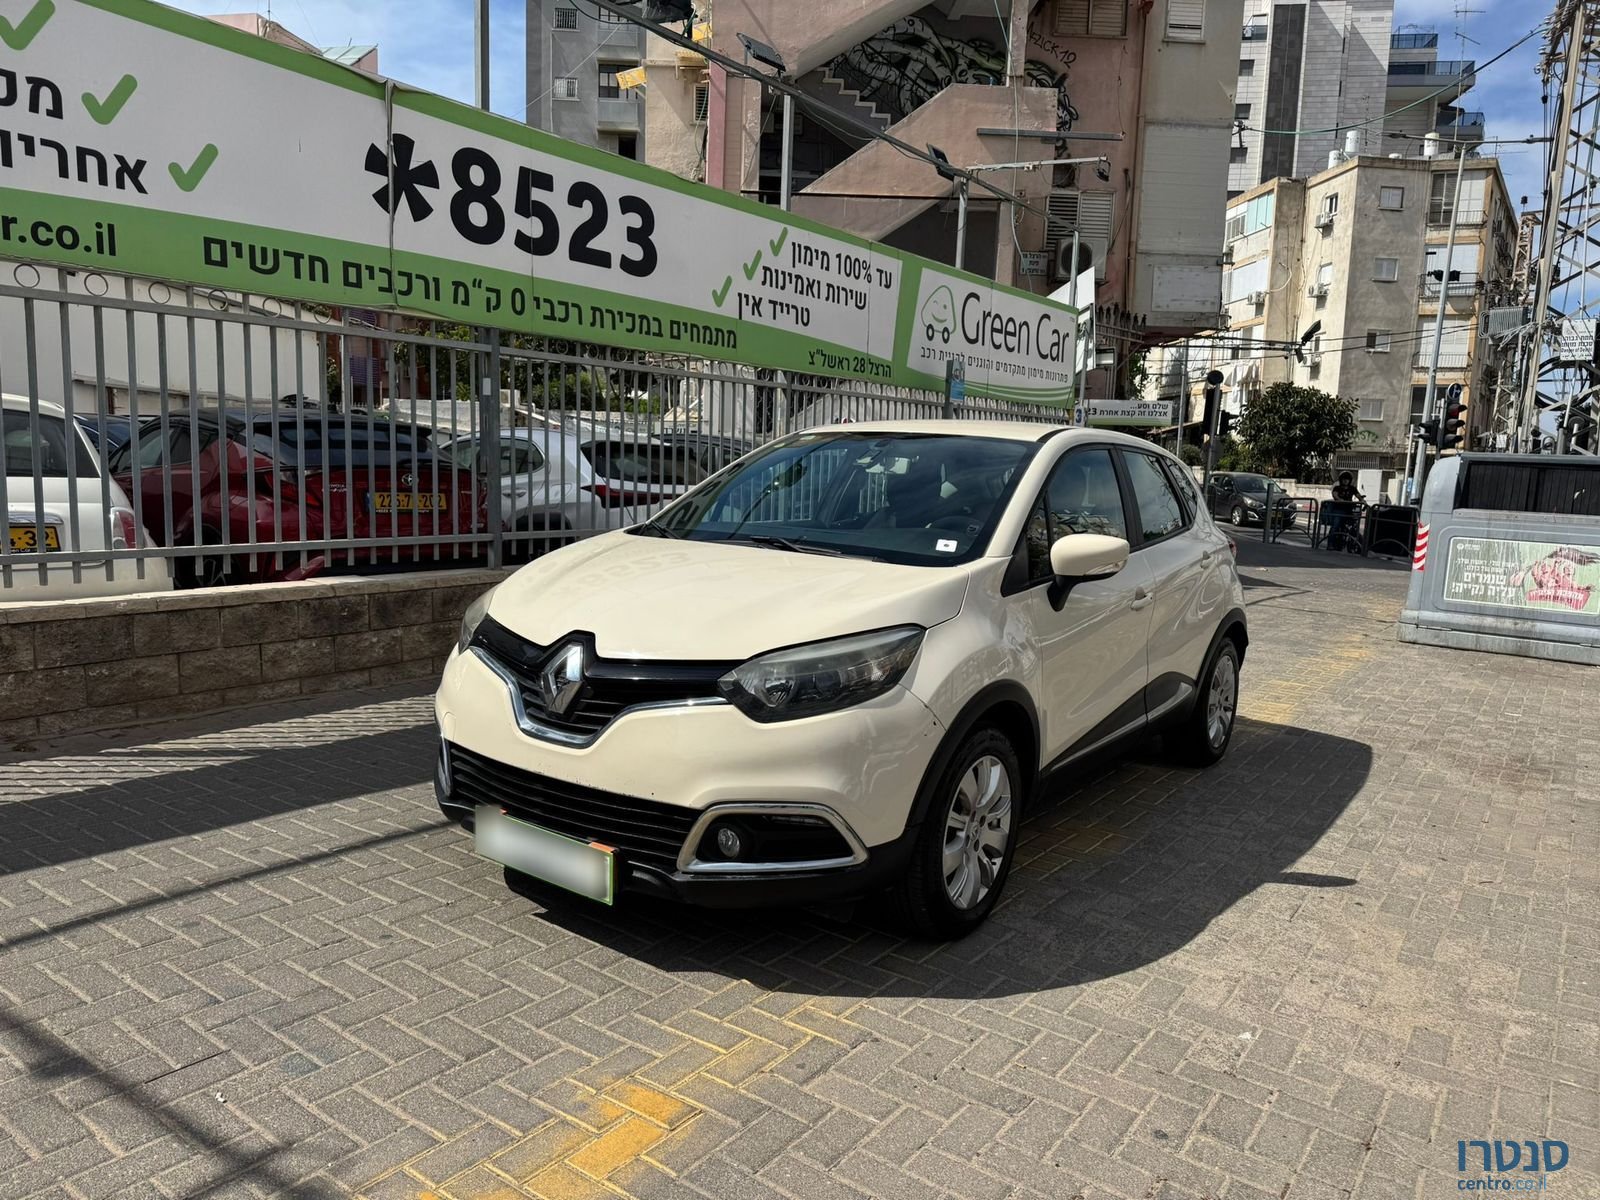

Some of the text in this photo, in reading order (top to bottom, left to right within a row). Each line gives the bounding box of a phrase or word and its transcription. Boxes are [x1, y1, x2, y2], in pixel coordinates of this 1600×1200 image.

[203, 235, 330, 285] חדשים
[791, 240, 893, 290] עד 100% מימון
[342, 260, 441, 306] ורכבים
[761, 264, 868, 311] שירות ואמינות
[534, 296, 584, 326] רכבי
[737, 291, 811, 327] טרייד אין
[590, 303, 664, 338] במכירת
[961, 292, 1070, 364] Green Car
[670, 319, 738, 350] מתמחים
[920, 346, 936, 360] רכב
[968, 355, 994, 371] והוגנים
[853, 356, 867, 374] 28
[868, 357, 893, 379] הרצל
[996, 360, 1026, 377] מתקדמים
[1027, 366, 1044, 380] מימון
[1045, 370, 1069, 384] פתרונות
[1121, 409, 1136, 418] קצת
[1137, 409, 1146, 417] זה
[1148, 409, 1168, 417] אצלנו
[1152, 402, 1169, 410] שלם
